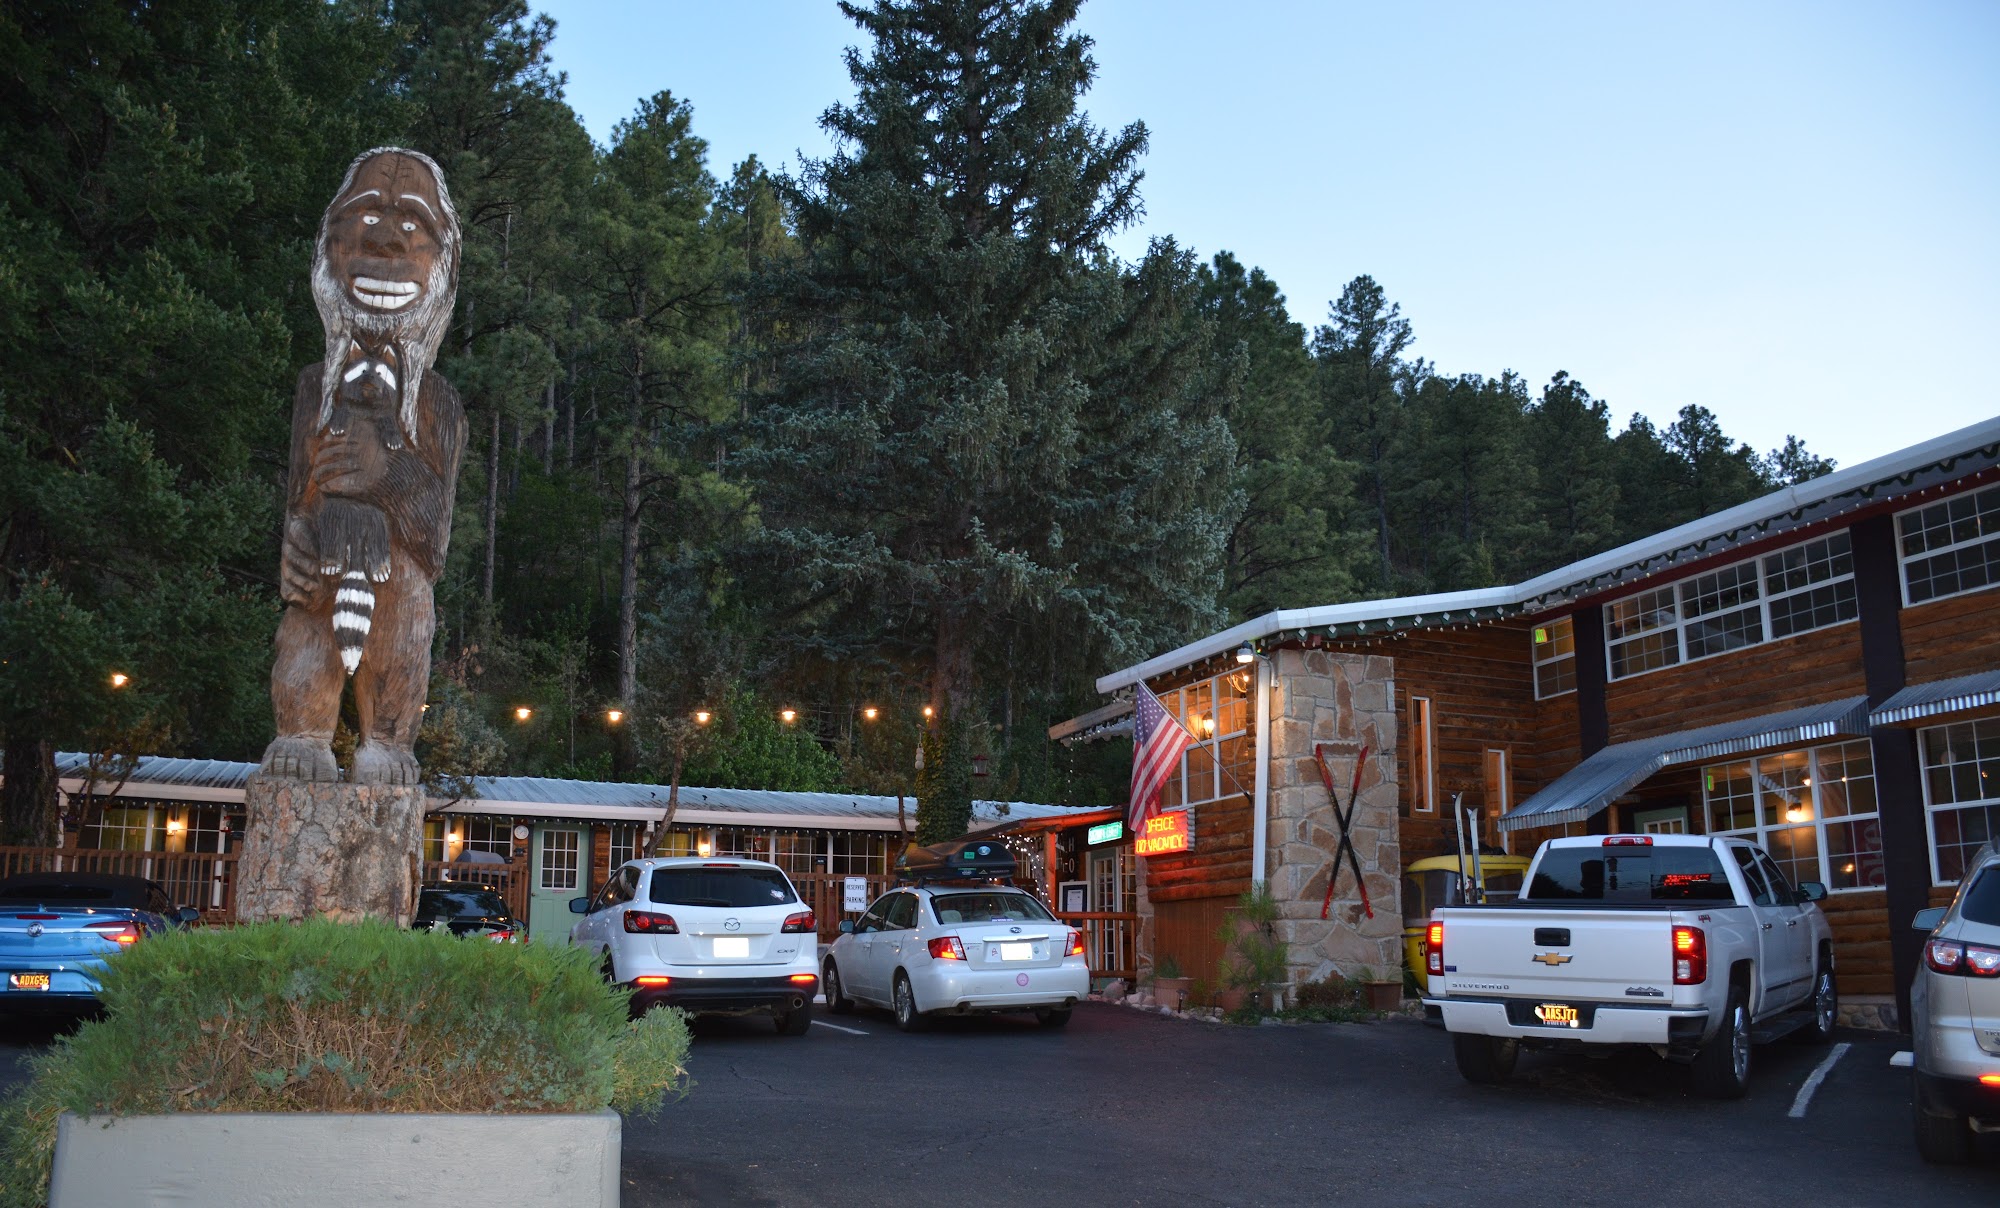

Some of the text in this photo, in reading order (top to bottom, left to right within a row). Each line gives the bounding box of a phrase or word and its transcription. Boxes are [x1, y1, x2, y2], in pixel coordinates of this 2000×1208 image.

[1136, 834, 1184, 853] NO VACANCY
[846, 896, 865, 904] PARKING
[19, 975, 50, 986] ADXG56
[1544, 1007, 1577, 1020] AASJ77
